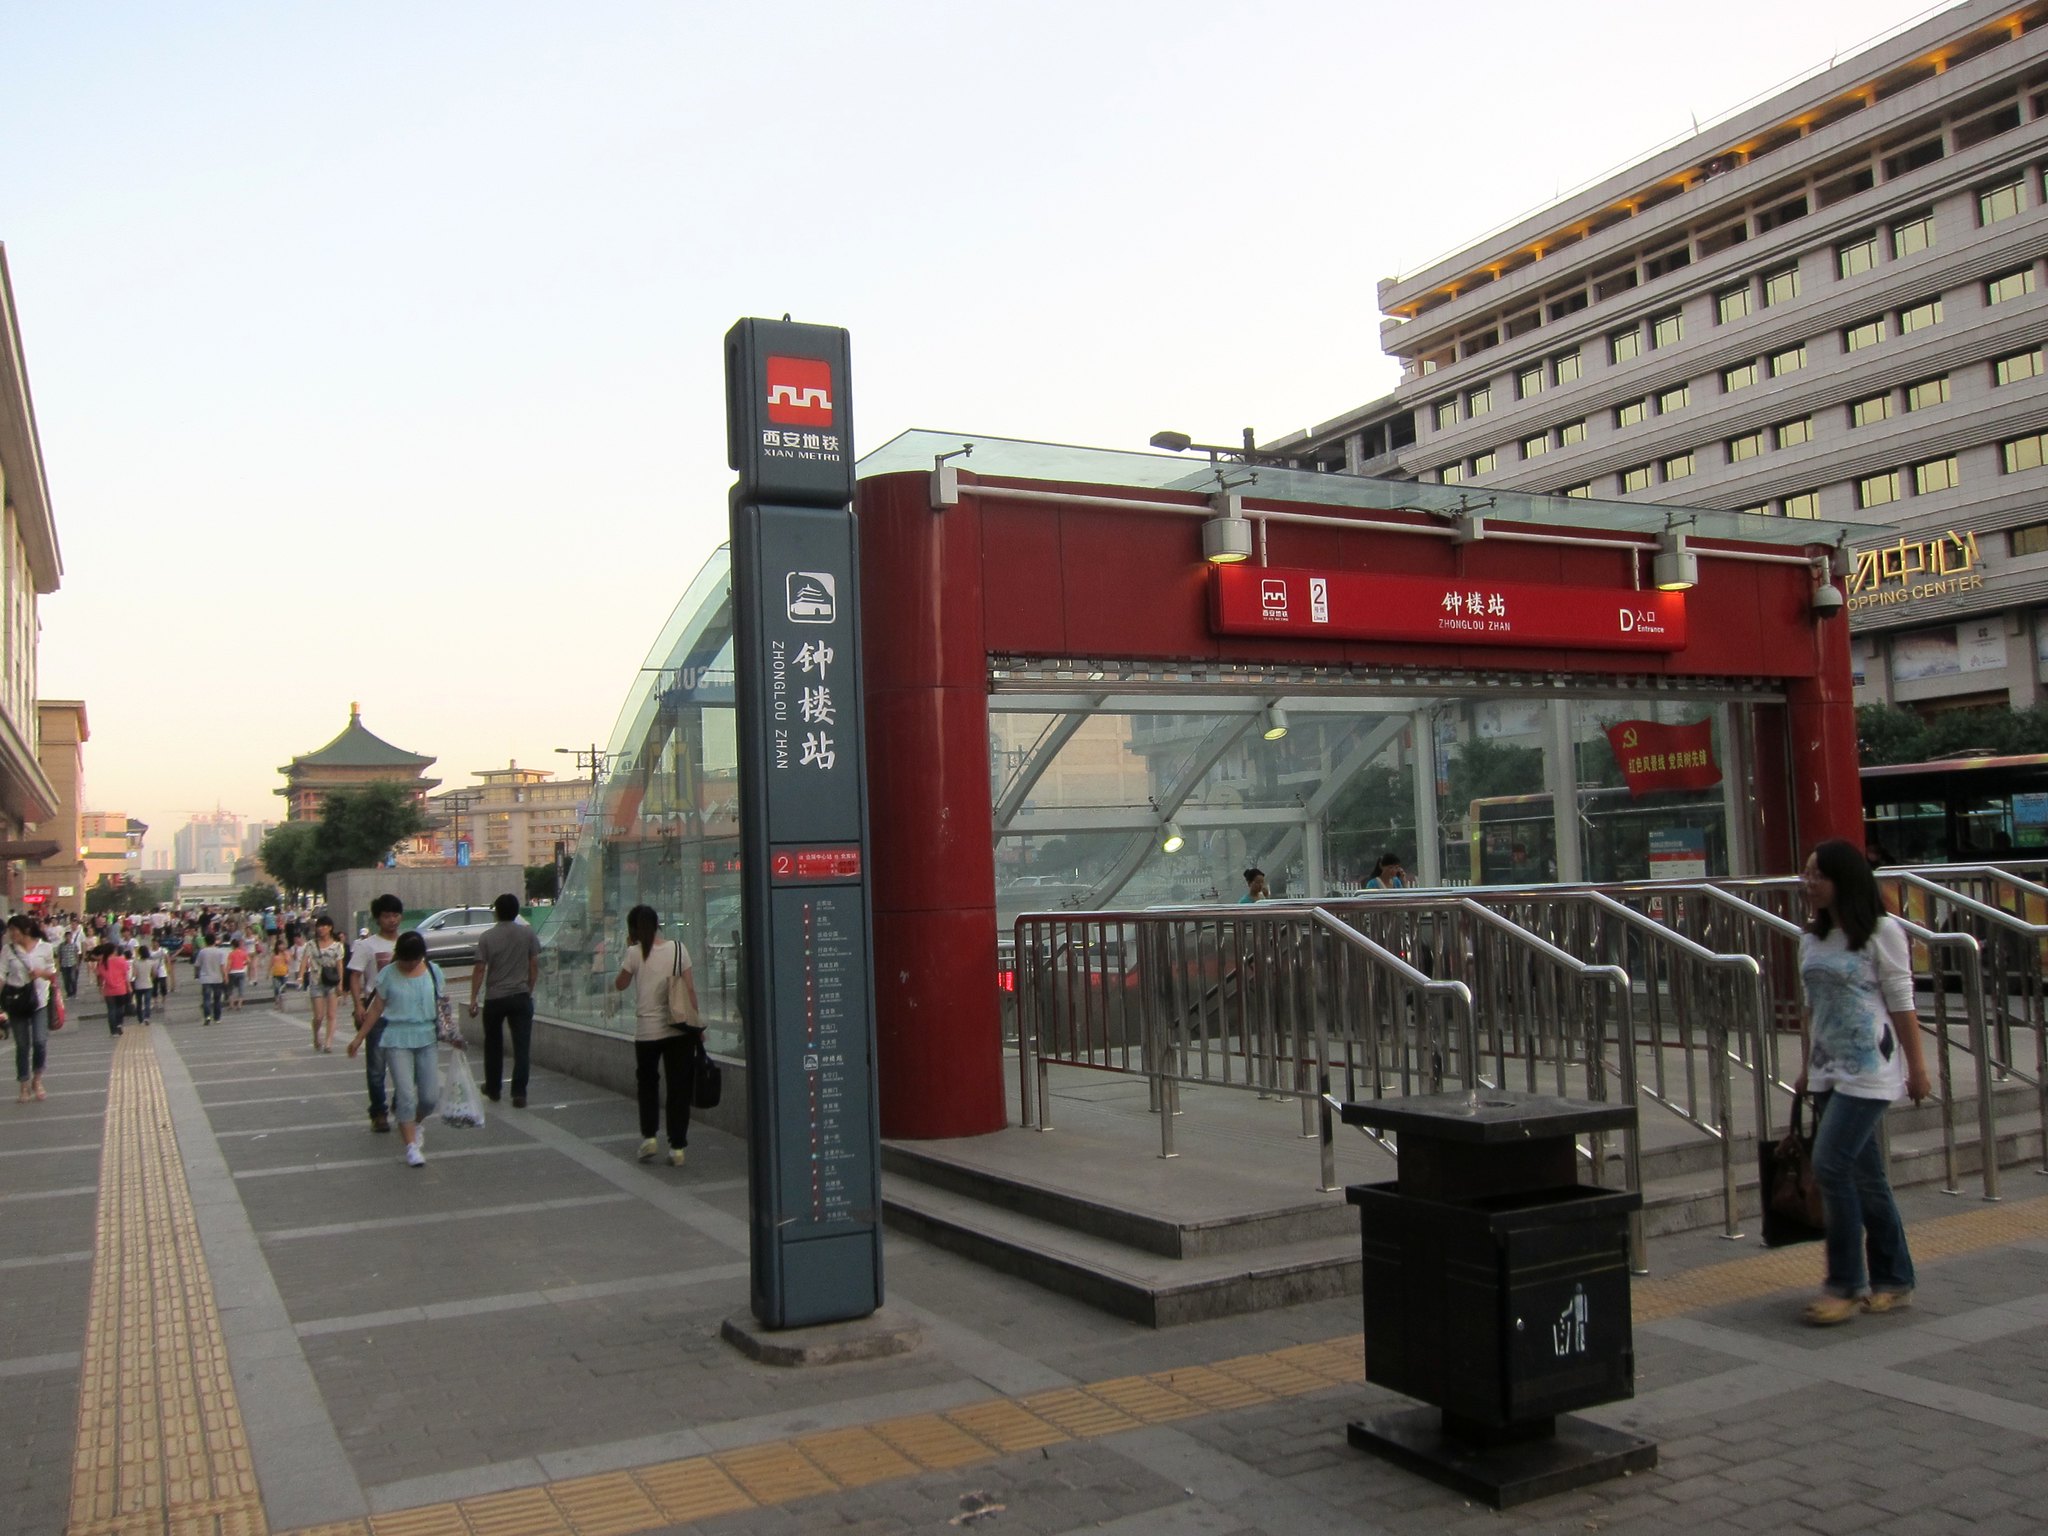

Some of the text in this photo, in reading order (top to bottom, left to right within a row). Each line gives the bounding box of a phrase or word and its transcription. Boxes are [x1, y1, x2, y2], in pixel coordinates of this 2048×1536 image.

[762, 429, 839, 452] 西安地铁
[764, 448, 840, 462] XIAN METRO
[1313, 583, 1324, 604] 2
[1912, 574, 1983, 599] CENTER
[1441, 590, 1506, 617] 钟楼站
[1438, 618, 1511, 632] ZHONGLOU ZHAN
[1619, 608, 1634, 632] D
[1636, 610, 1656, 622] 入口
[1637, 624, 1665, 634] Entrance
[772, 640, 789, 769] ZHONGLOU ZHAN
[791, 639, 837, 770] 钟楼站
[1629, 754, 1666, 773] 红色风景线
[777, 855, 790, 874] 2
